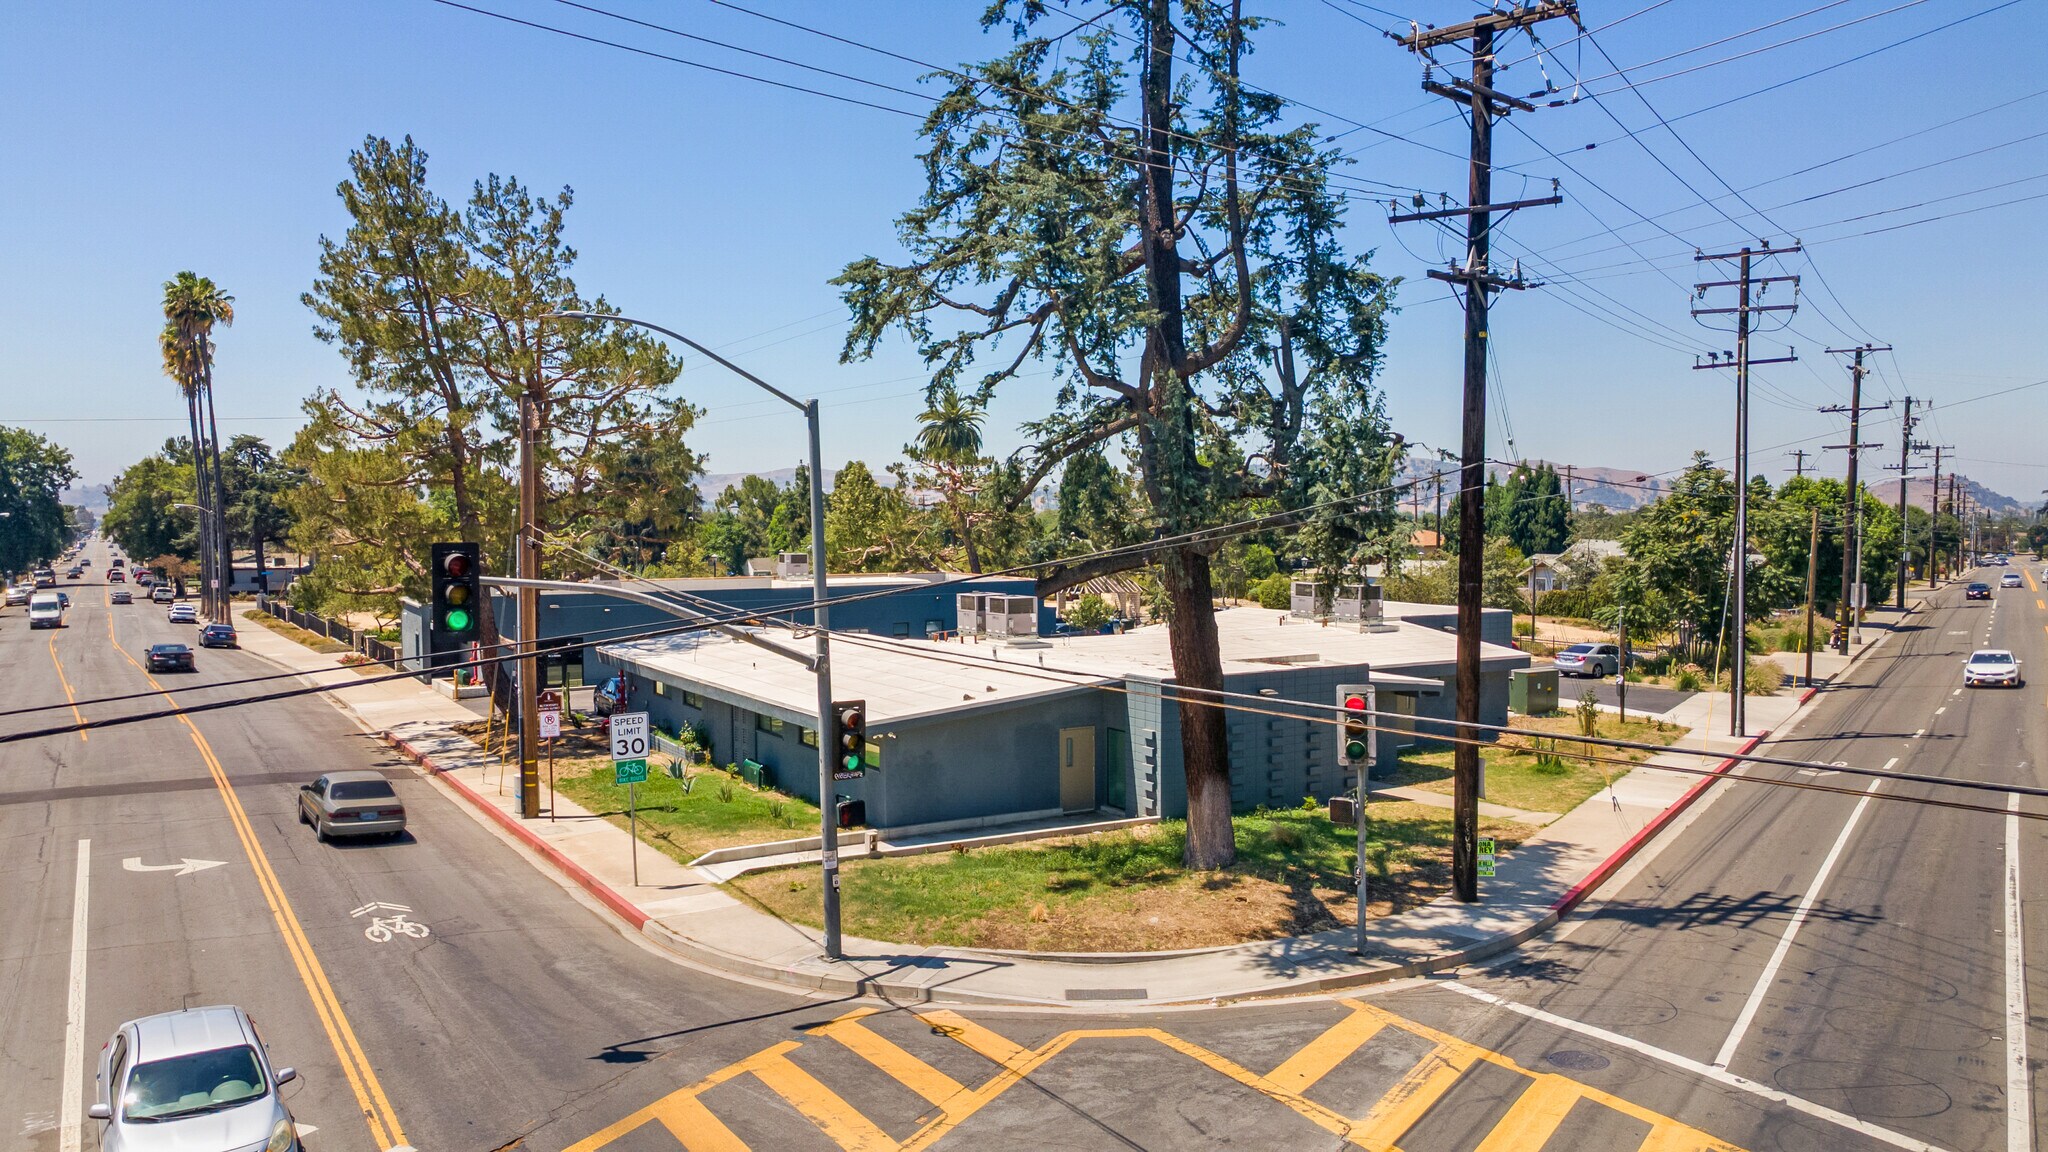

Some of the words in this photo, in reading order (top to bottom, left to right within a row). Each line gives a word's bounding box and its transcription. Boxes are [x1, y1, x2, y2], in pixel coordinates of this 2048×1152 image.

[614, 717, 644, 726] SPEED
[618, 727, 641, 736] LIMIT
[616, 738, 645, 756] 30
